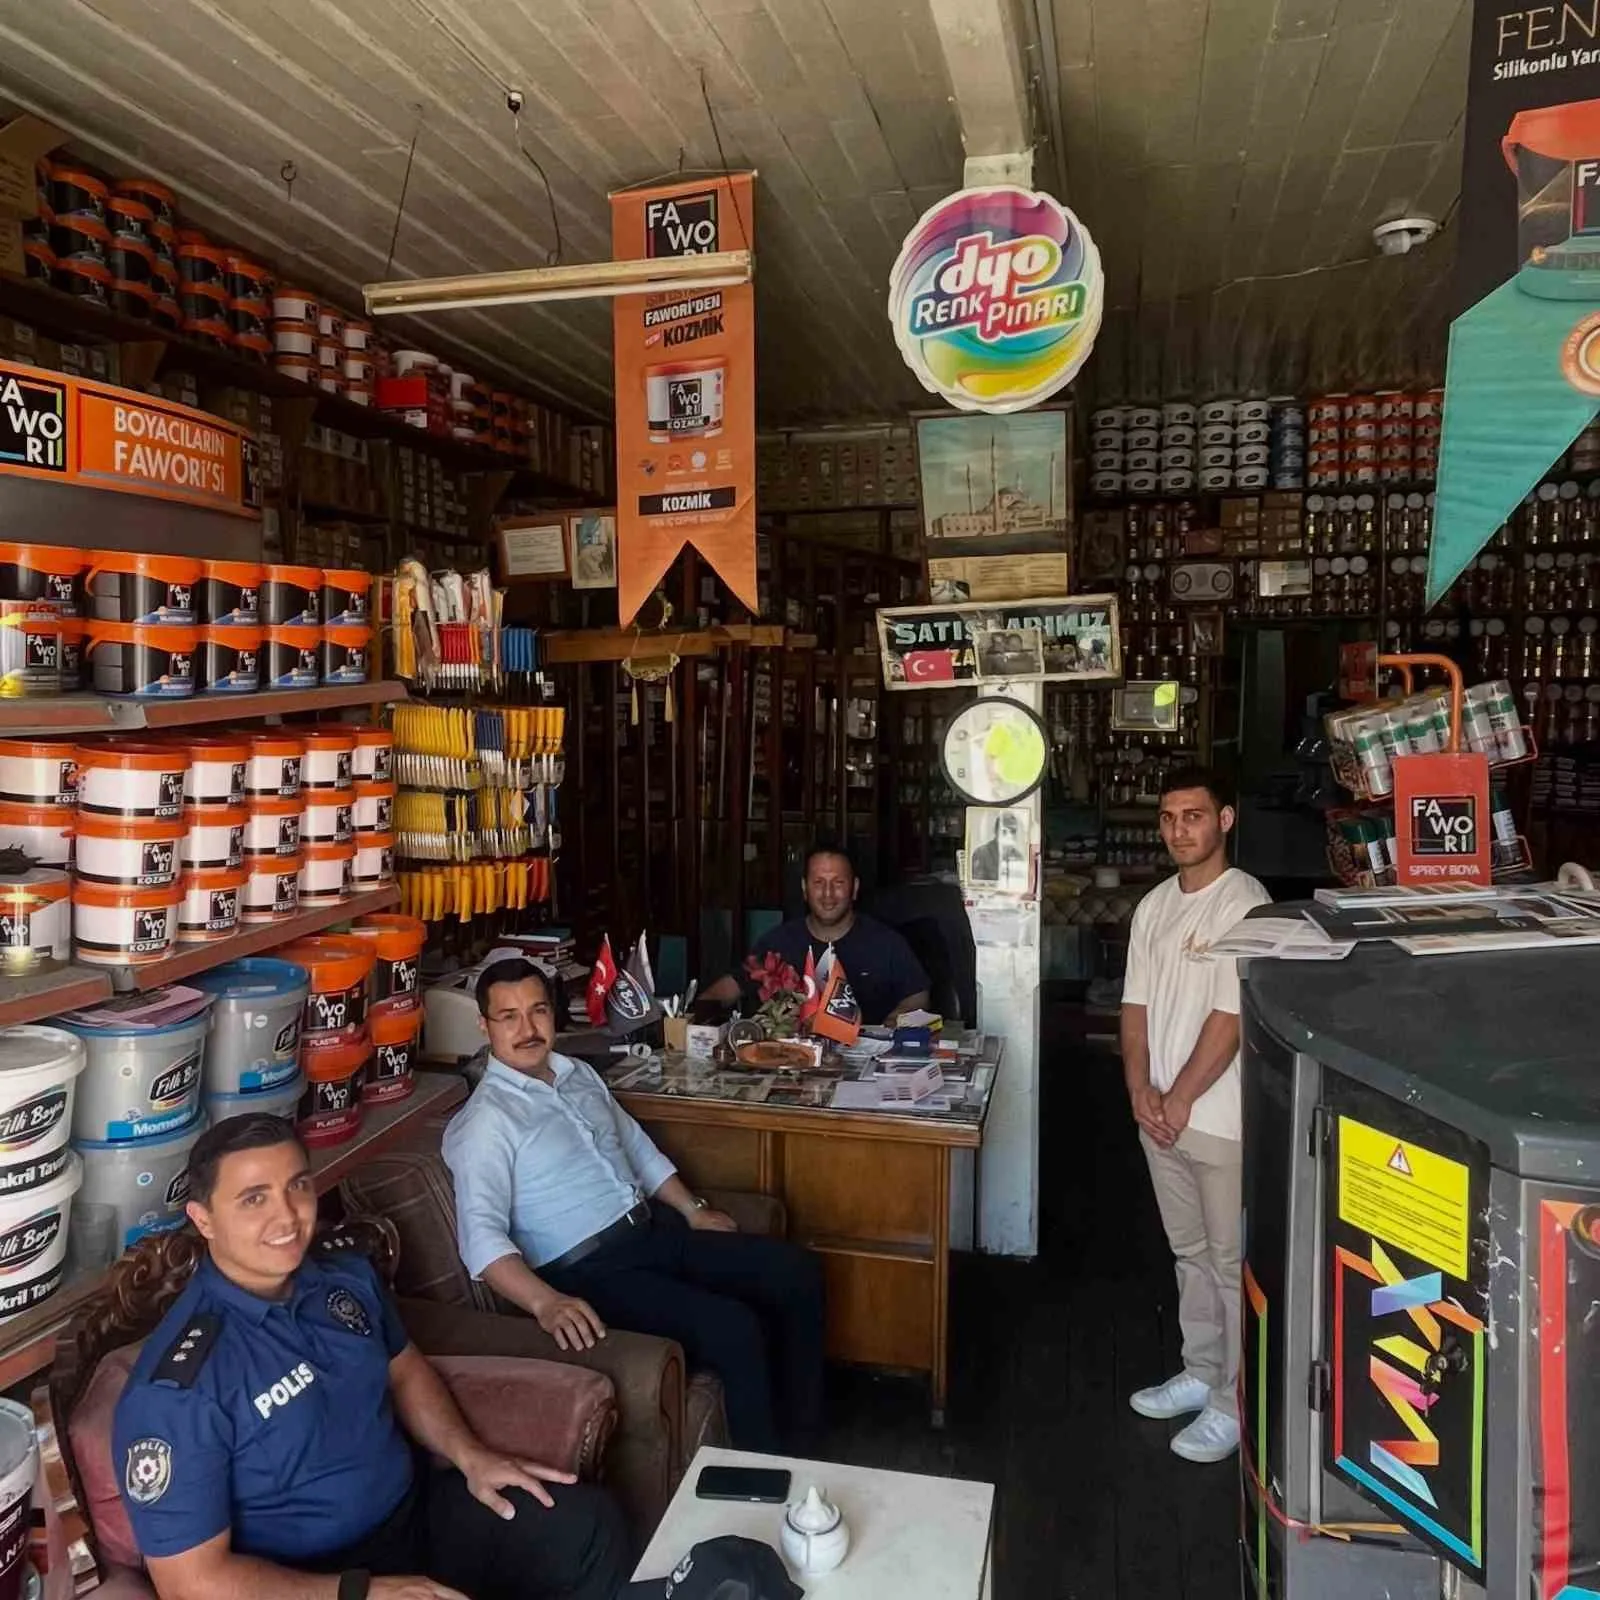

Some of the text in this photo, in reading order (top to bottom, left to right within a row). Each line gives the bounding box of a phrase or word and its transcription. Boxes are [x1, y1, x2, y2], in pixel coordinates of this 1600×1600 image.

[1493, 52, 1568, 81] Silikonlu
[1578, 163, 1600, 187] F
[648, 201, 681, 229] FA
[666, 220, 716, 251] WO
[940, 244, 1049, 299] dyo
[0, 376, 24, 406] A
[7, 405, 62, 440] WO
[114, 406, 225, 457] BOYACILARIN
[27, 436, 55, 466] RI
[1413, 799, 1442, 818] FA
[1429, 815, 1474, 835] WO
[1444, 834, 1467, 852] RI
[1408, 864, 1480, 877] SPREY BOYA
[135, 910, 152, 922] FA
[144, 919, 166, 931] WO
[151, 929, 164, 940] RI
[307, 994, 327, 1007] FA
[318, 1003, 346, 1017] WO
[327, 1015, 343, 1029] RI
[377, 1046, 394, 1058] FA
[387, 1051, 408, 1067] WO
[394, 1064, 405, 1077] RI
[317, 1082, 333, 1094] FA
[326, 1088, 348, 1103] WO
[30, 1100, 64, 1126] Boya
[333, 1099, 345, 1110] RI
[0, 1222, 58, 1258] illi Boya
[0, 1289, 28, 1312] kril
